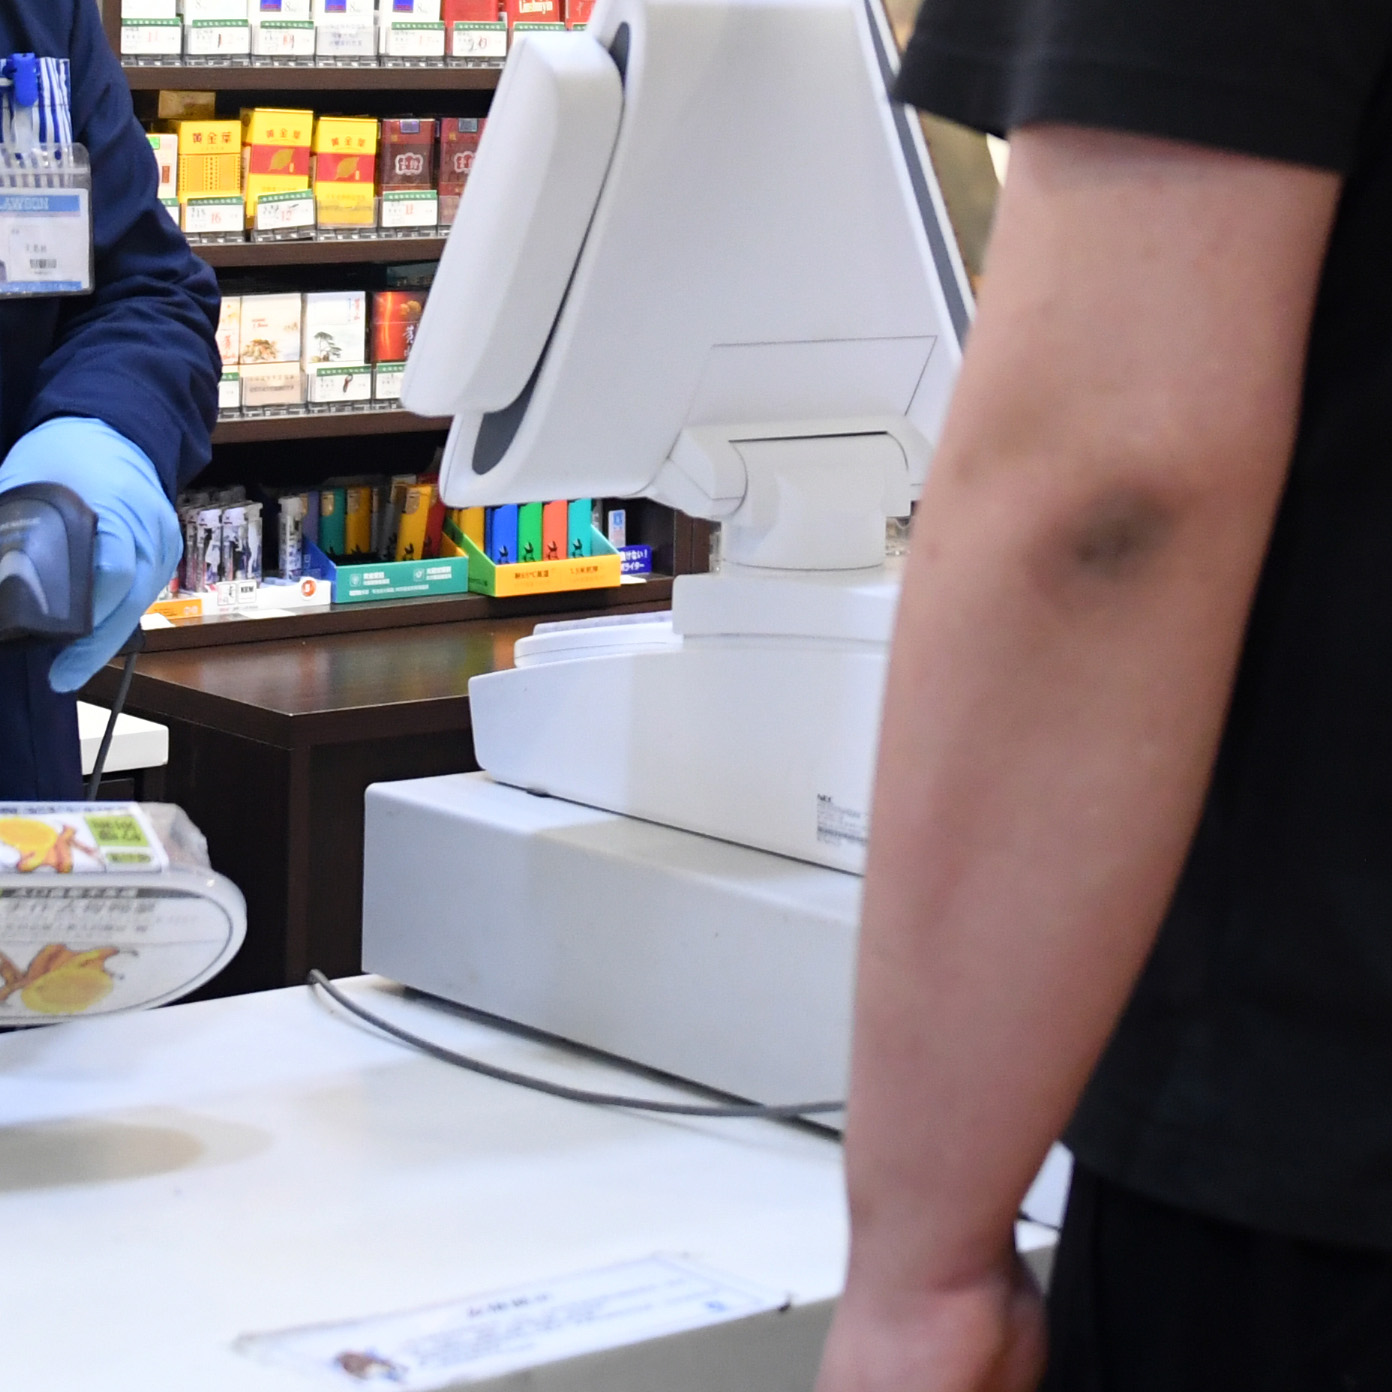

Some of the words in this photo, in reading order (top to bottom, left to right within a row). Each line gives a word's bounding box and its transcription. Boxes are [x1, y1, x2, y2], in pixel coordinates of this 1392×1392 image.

[192, 131, 232, 145] 黄金叶
[265, 128, 301, 141] 黄金叶
[330, 135, 366, 148] 黄金叶
